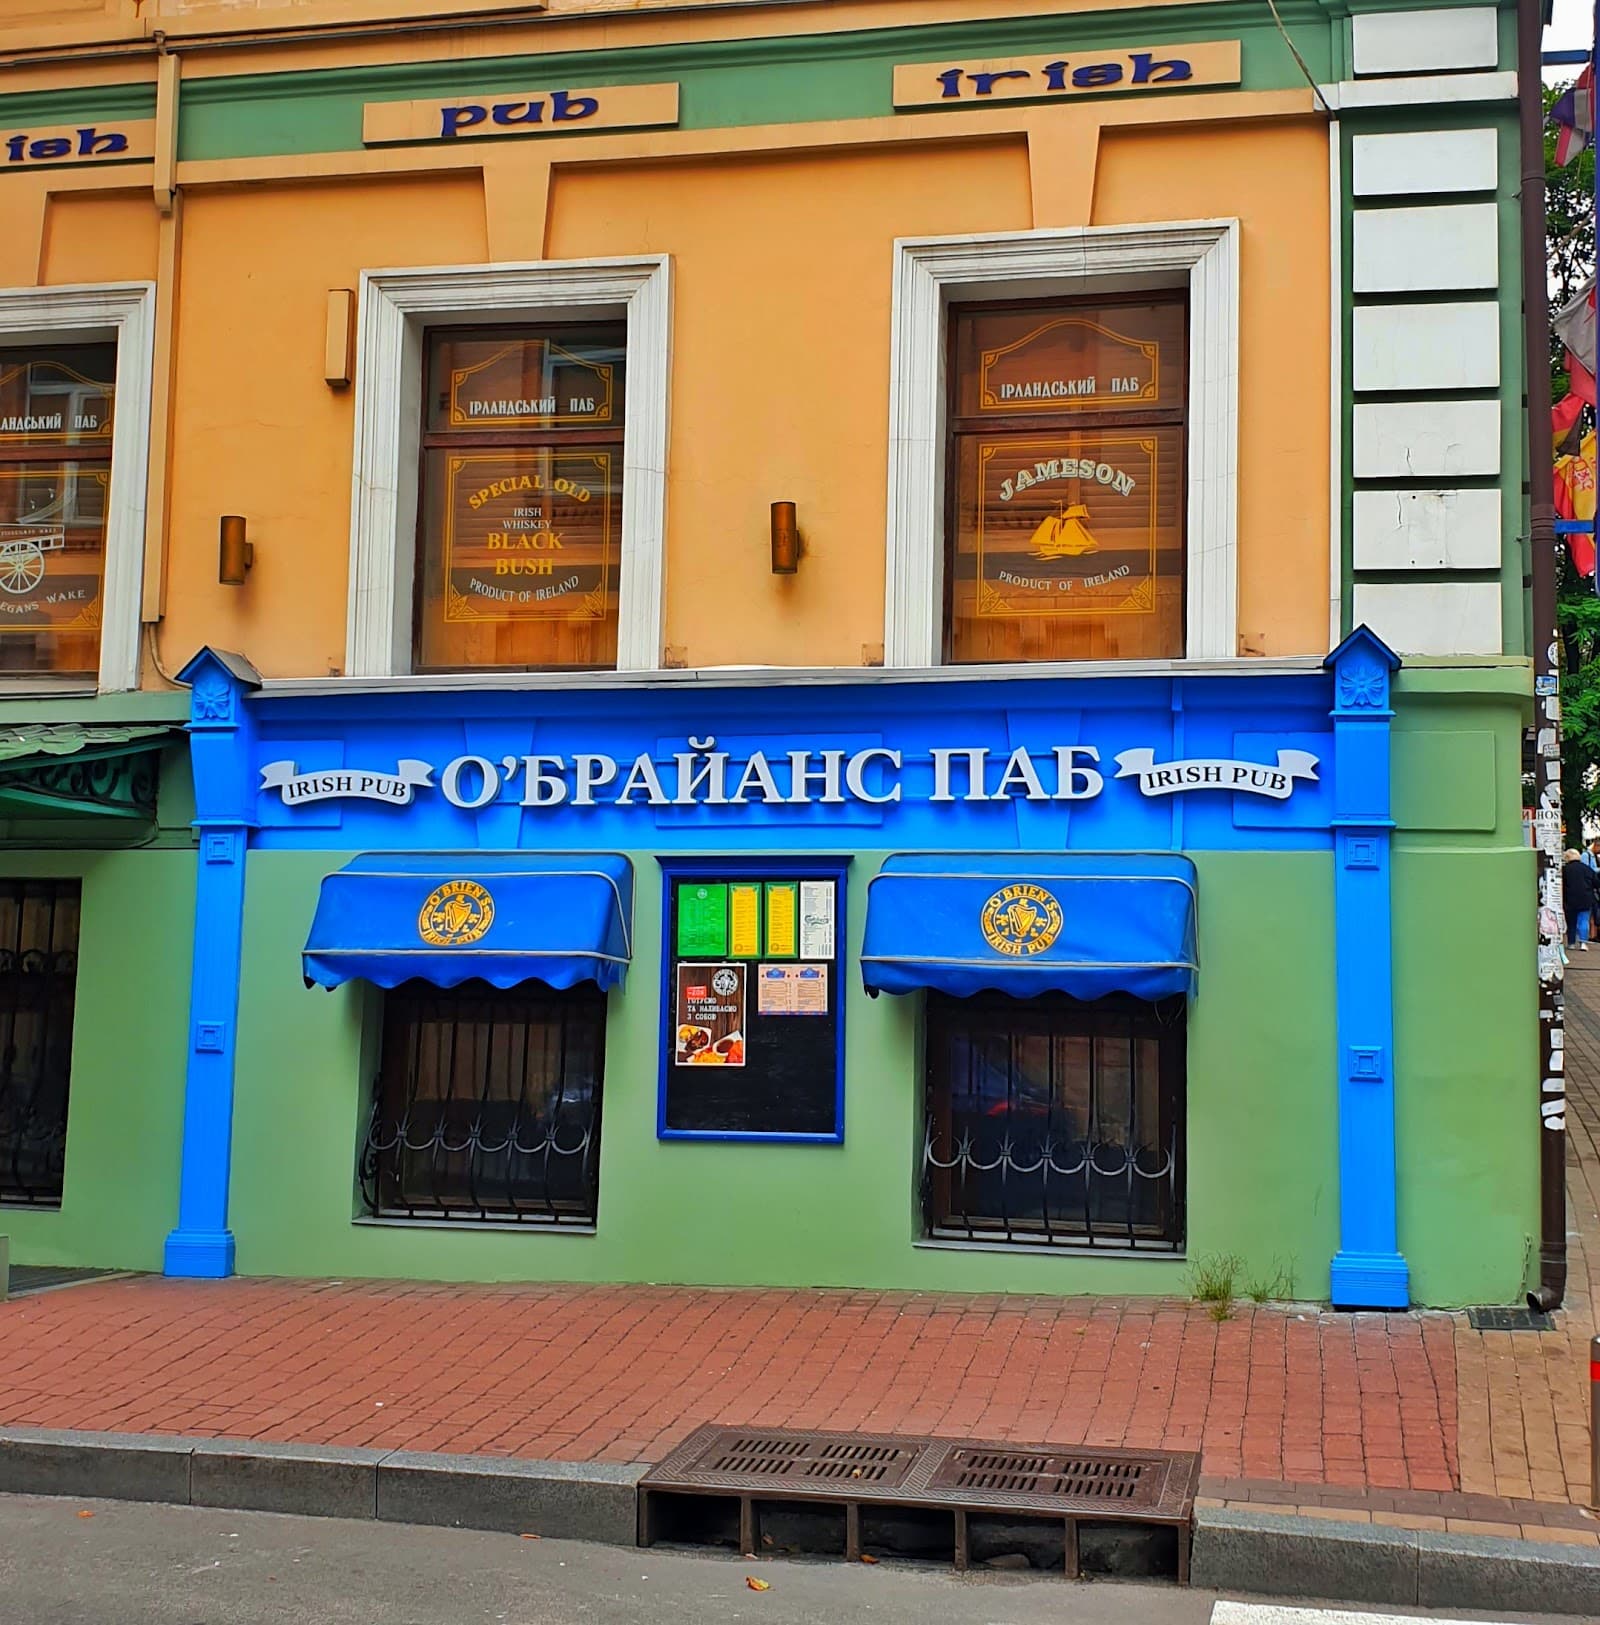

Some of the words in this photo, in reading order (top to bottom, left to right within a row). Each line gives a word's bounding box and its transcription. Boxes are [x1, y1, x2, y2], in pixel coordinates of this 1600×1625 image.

[936, 53, 1193, 98] irish
[441, 91, 599, 137] pub
[1001, 376, 1096, 398] ІРЛАНДСЬКИЙ
[1112, 377, 1139, 393] ПАБ
[469, 396, 556, 416] ІРЛАНДСЬКИЙ
[570, 397, 595, 413] ПАБ
[0, 413, 62, 431] АНДСЬКИЙ
[74, 415, 97, 428] ПАБ
[1000, 458, 1136, 501] JAMESON
[468, 475, 545, 510] SPECIAL
[554, 478, 591, 503] OLD
[503, 519, 552, 529] WHISKEY
[513, 507, 542, 517] IRISH
[487, 532, 564, 550] BLACK
[495, 558, 553, 575] BUSH
[1000, 571, 1053, 591] PRODUCT
[1059, 581, 1073, 591] OF
[1084, 565, 1130, 588] IRELAND
[46, 589, 86, 604] WAKE
[469, 578, 515, 603] PRODUCT
[518, 591, 531, 603] OF
[536, 575, 579, 601] IRELAND
[441, 736, 902, 809] О'БРАЙАНС
[929, 745, 1104, 801] ПАБ
[1146, 765, 1221, 790] IRISH
[1232, 767, 1288, 791] PUB
[287, 775, 353, 799] IRISH
[360, 777, 406, 798] PUB
[429, 882, 491, 906] O'BRIEN'S
[989, 885, 1057, 911] O'BRIEN'S
[988, 933, 1021, 955] IRISH
[1027, 933, 1053, 954] PUB
